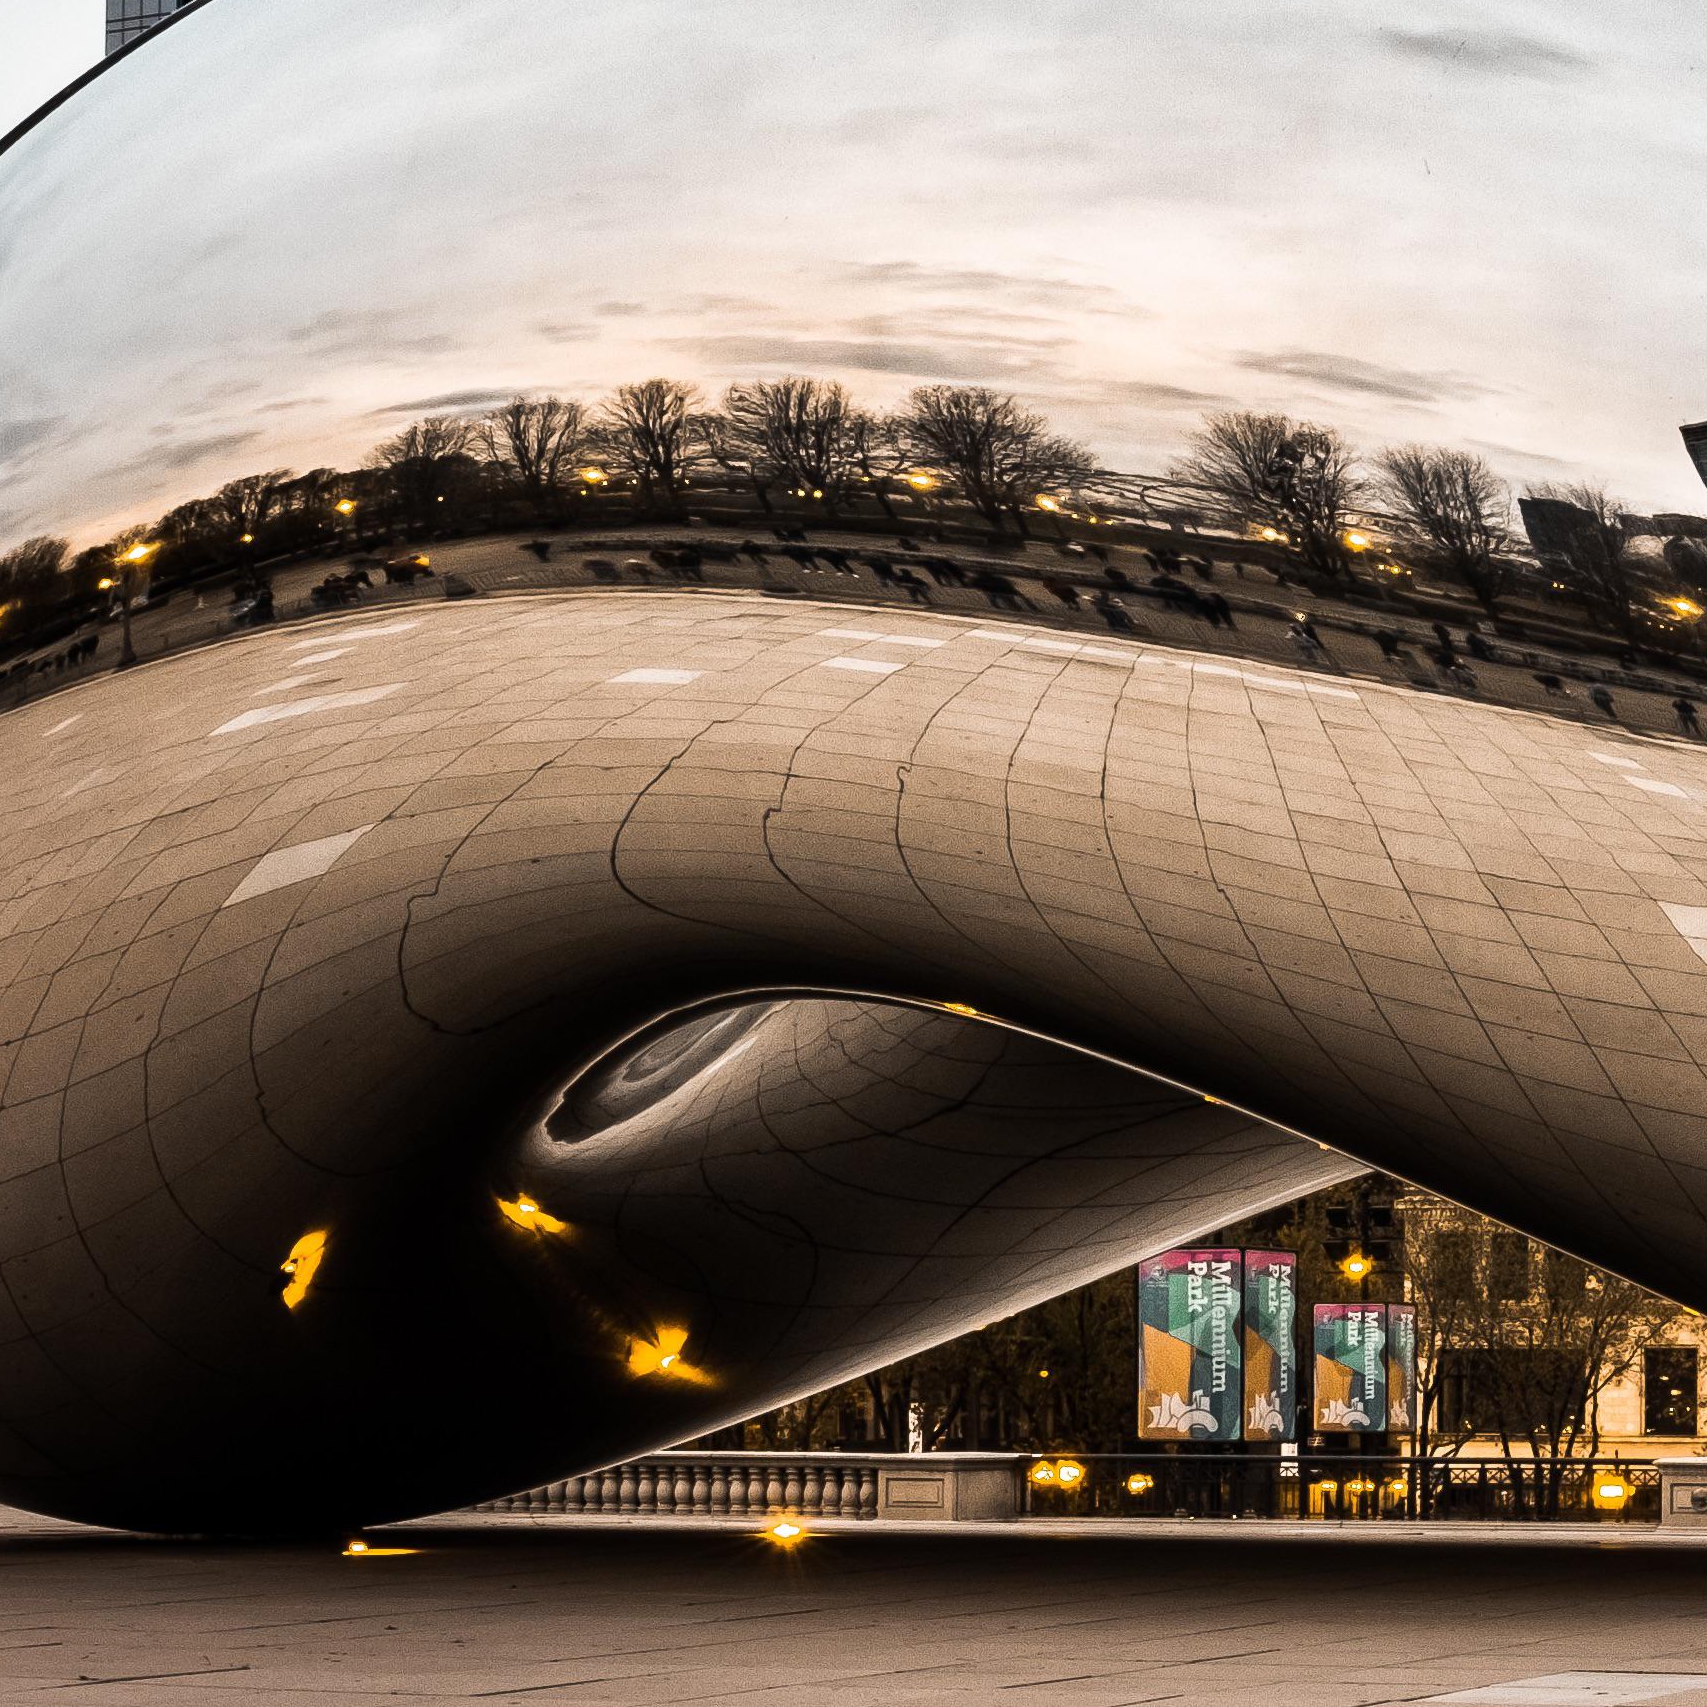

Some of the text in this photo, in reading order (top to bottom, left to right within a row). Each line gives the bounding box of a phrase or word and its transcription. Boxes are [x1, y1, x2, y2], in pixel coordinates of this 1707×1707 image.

[1187, 1260, 1208, 1313] Park
[1268, 1262, 1280, 1314] Park
[1211, 1260, 1231, 1393] Millennium
[1280, 1264, 1291, 1393] Millennium
[1347, 1311, 1363, 1347] Park
[1364, 1311, 1379, 1400] Millennium
